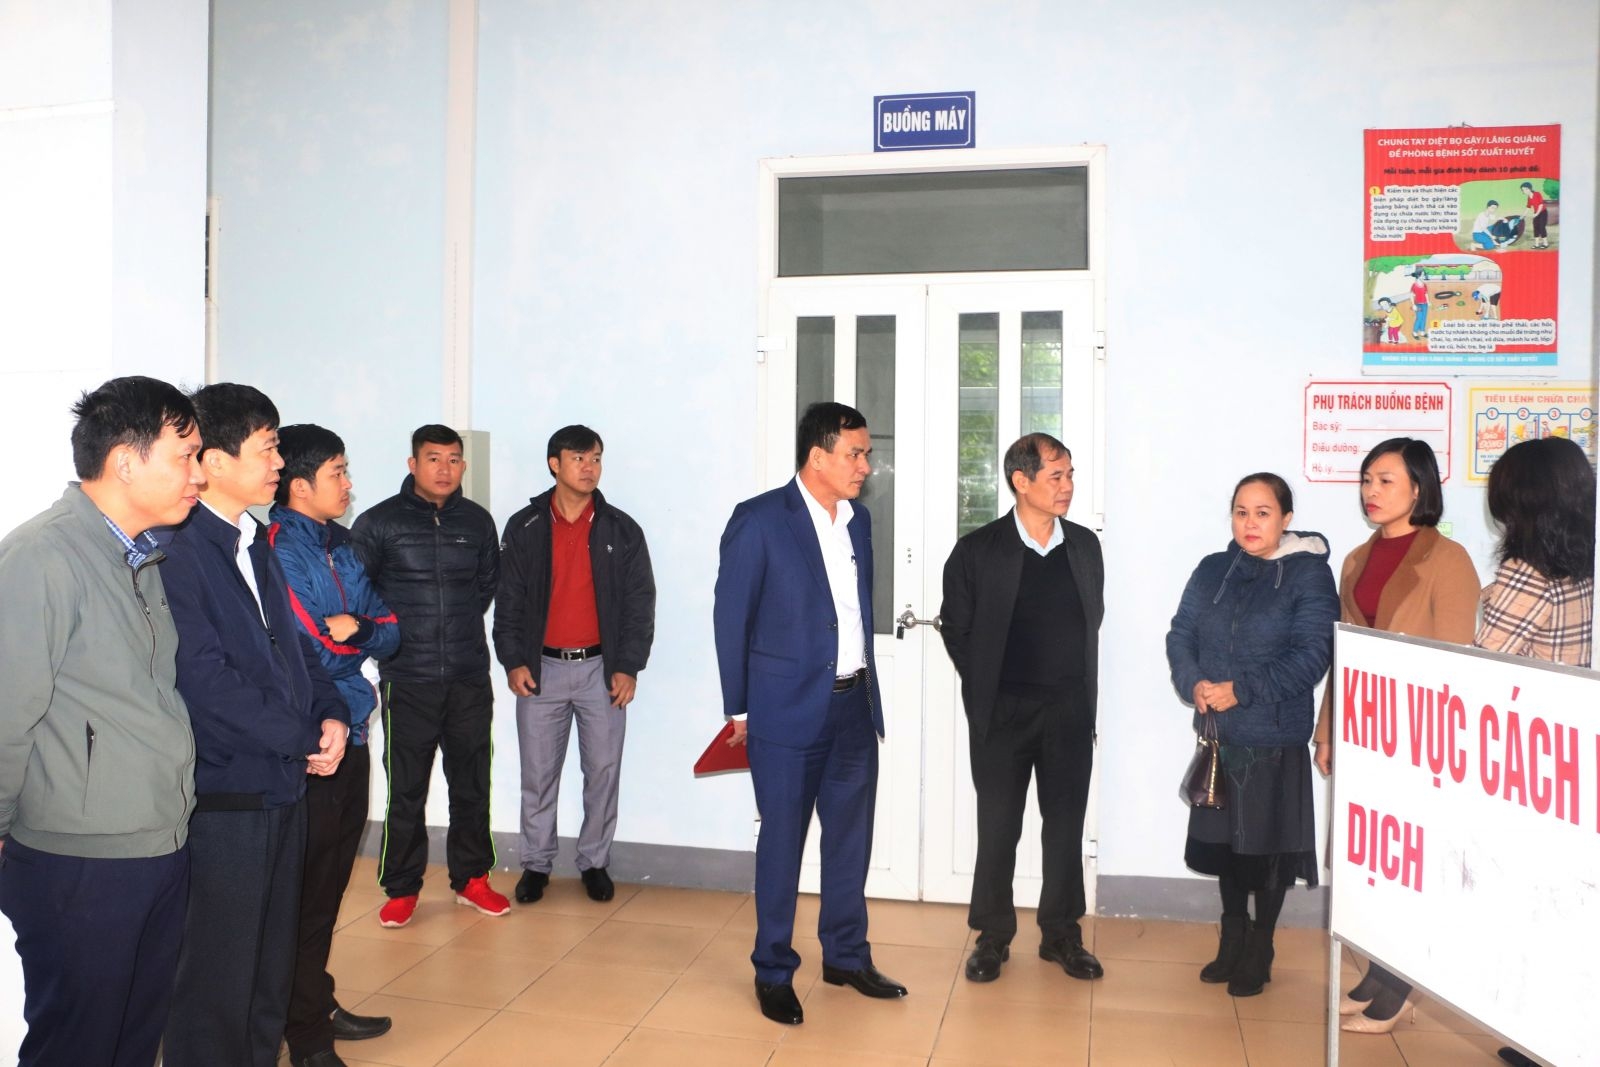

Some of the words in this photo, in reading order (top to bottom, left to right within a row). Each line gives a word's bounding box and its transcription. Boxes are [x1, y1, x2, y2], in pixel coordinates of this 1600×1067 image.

[883, 104, 931, 133] BUỒNG
[935, 105, 966, 131] MÁY
[1378, 138, 1409, 146] CHUNG
[1411, 138, 1426, 146] TAY
[1428, 137, 1448, 147] DIỆT
[1449, 137, 1462, 147] BỌ
[1402, 149, 1434, 158] PHÒNG
[1436, 148, 1460, 158] BỆNH
[1461, 147, 1479, 157] SỐT
[1480, 147, 1504, 156] XUẤT
[1505, 146, 1536, 156] HUYẾT
[1313, 395, 1334, 413] PHỤ
[1338, 391, 1372, 410] TRÁCH
[1415, 391, 1443, 413] BỆNH
[1551, 410, 1557, 418] 3
[1343, 666, 1397, 758] KHU
[1407, 683, 1467, 788] VỰC
[1479, 685, 1580, 826] CÁCH
[1347, 801, 1424, 893] DỊCH
